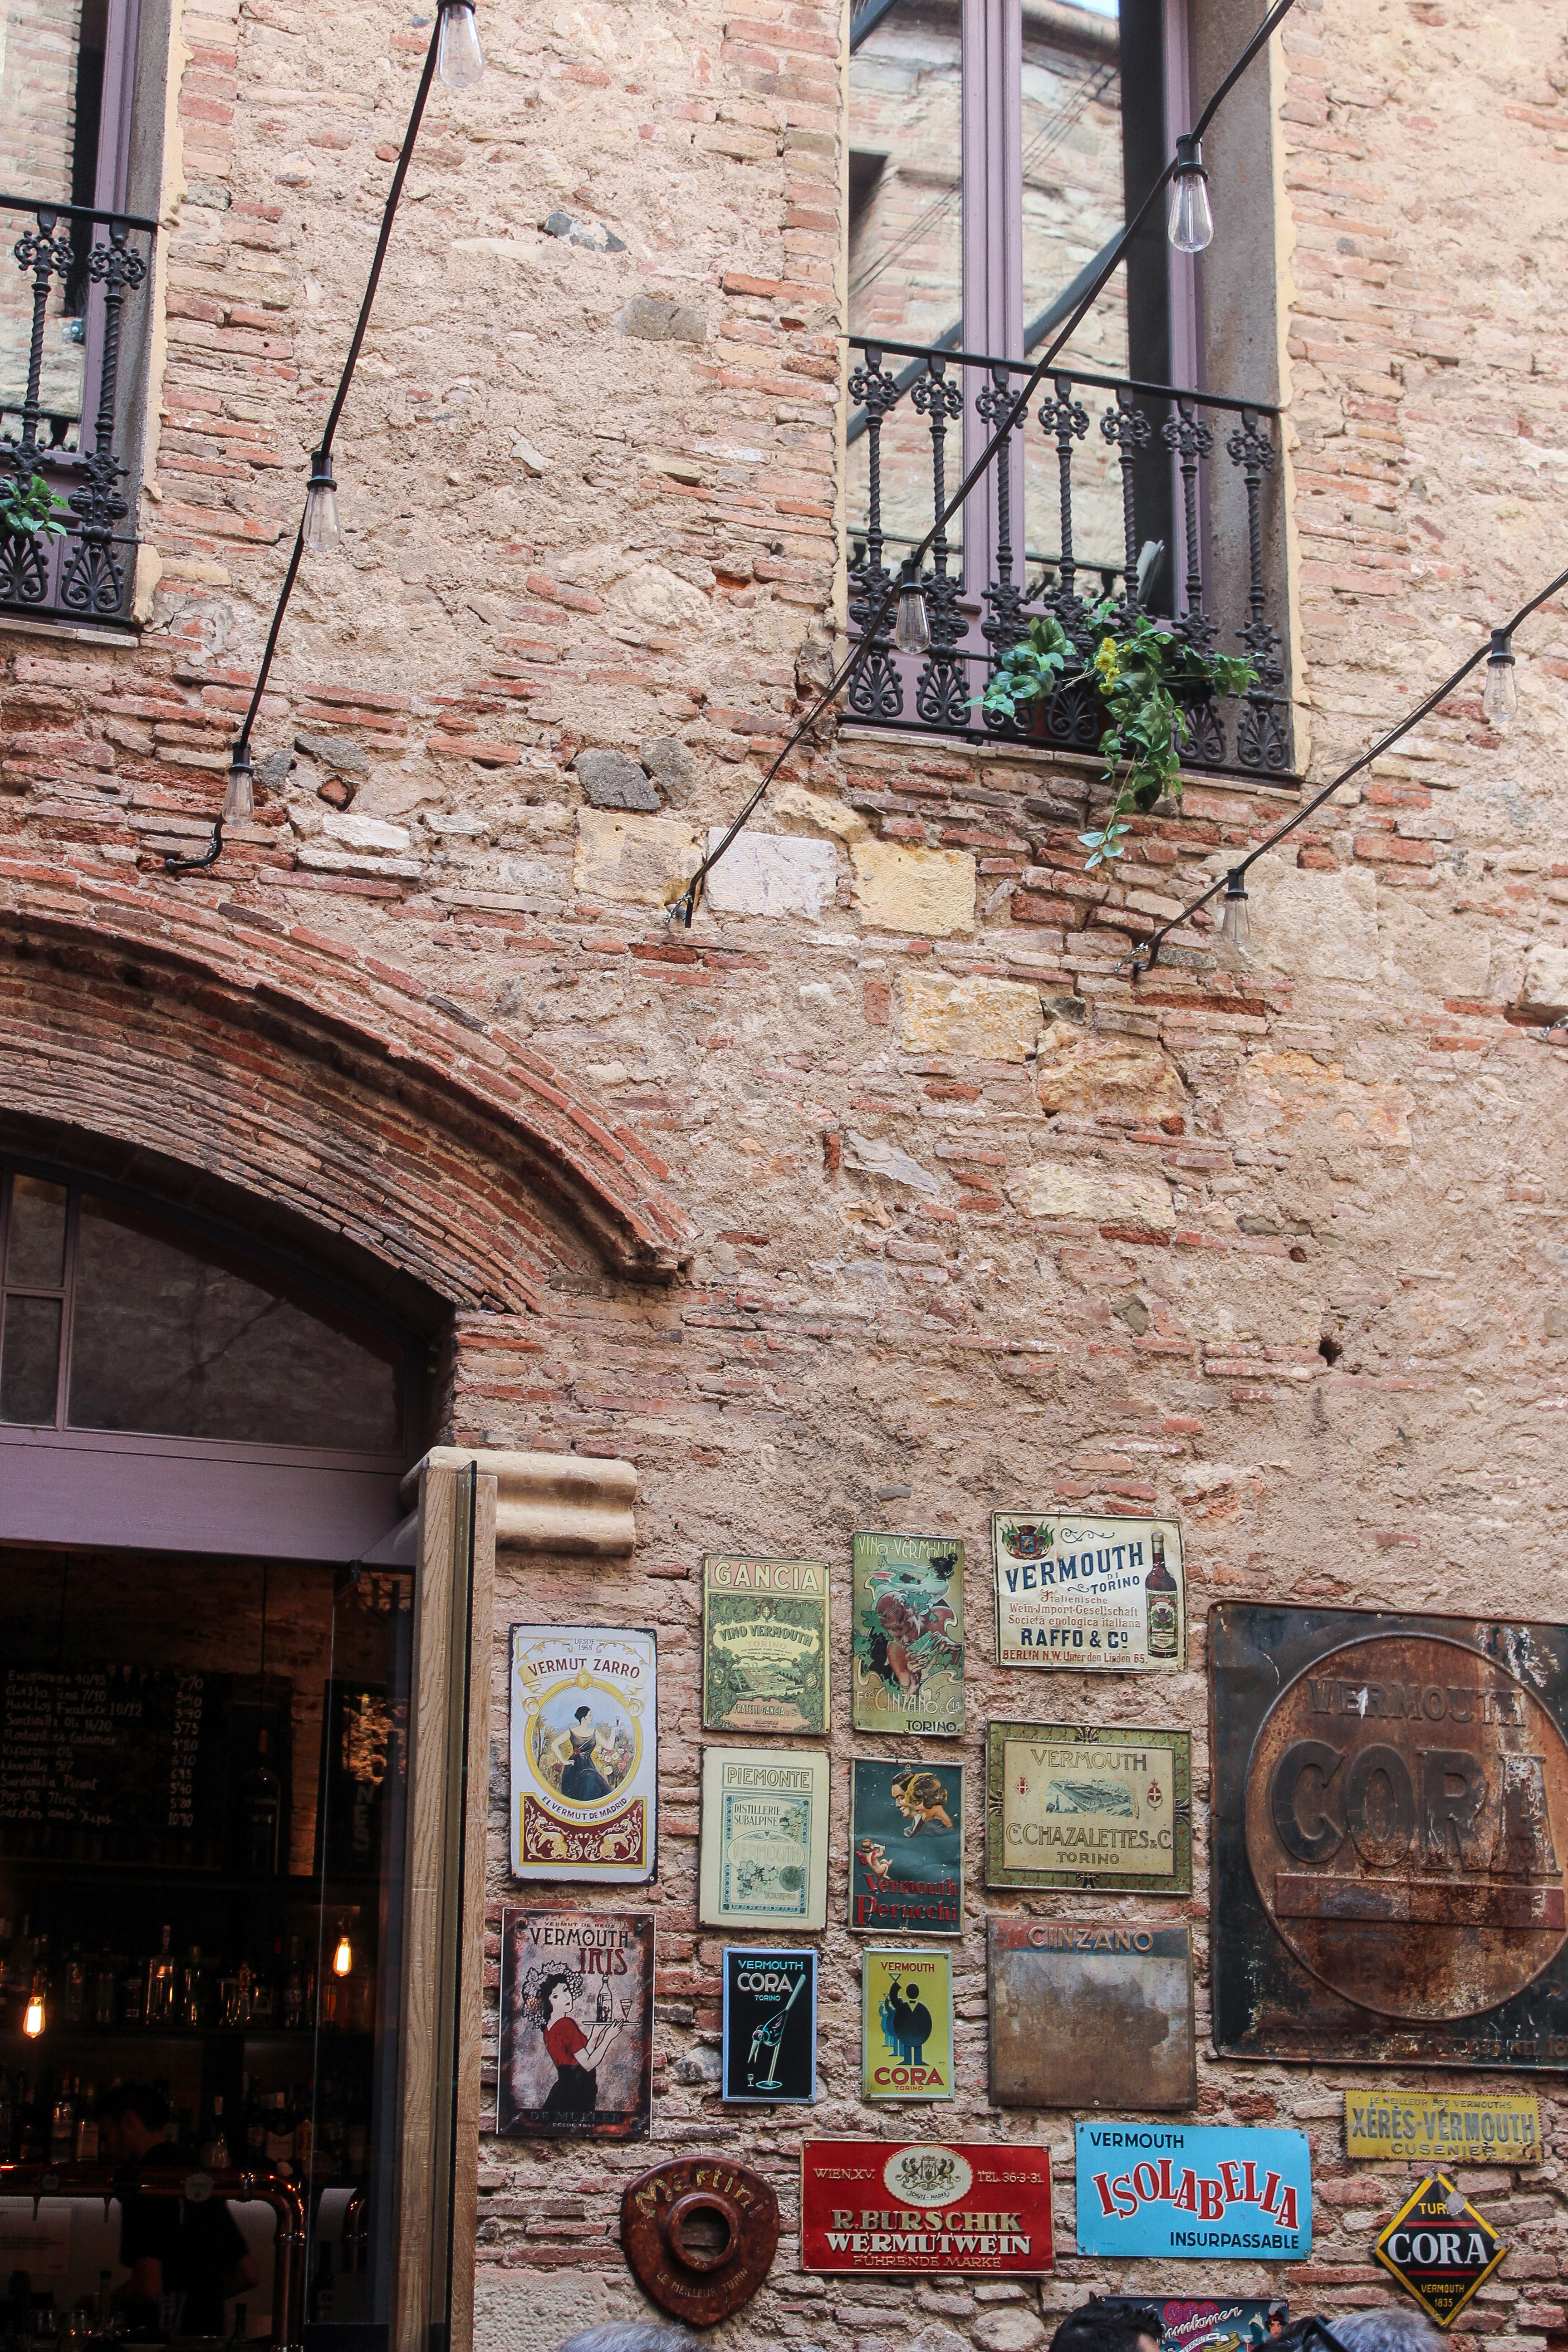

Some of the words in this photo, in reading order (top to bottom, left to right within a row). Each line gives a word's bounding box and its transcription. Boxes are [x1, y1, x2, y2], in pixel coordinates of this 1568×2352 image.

[715, 1562, 818, 1591] GANCIA
[1004, 1541, 1144, 1592] VERMOUTH
[1091, 1575, 1140, 1594] TORINO
[1049, 1616, 1098, 1628] enologica
[1102, 1617, 1140, 1627] italiana
[718, 1626, 747, 1642] VINO
[749, 1625, 813, 1646] VERMOUTH
[747, 1641, 786, 1649] TORINO
[1021, 1627, 1083, 1647] RAFFO
[1090, 1632, 1102, 1647] &
[1003, 1649, 1039, 1660] BERLIN
[1042, 1651, 1061, 1661] N.W.
[1063, 1651, 1085, 1661] Unter
[1088, 1651, 1101, 1662] den
[1104, 1653, 1130, 1663] Linden
[528, 1658, 587, 1677] VERMUT
[593, 1659, 640, 1678] ZARRO
[109, 1702, 143, 1716] 10/12
[733, 1704, 760, 1714] FRATELLI
[761, 1705, 784, 1715] GANCIA
[875, 1687, 938, 1714] CINZANO
[1308, 1677, 1527, 1727] VERMOUTH
[1031, 1749, 1147, 1771] VERMOUTH
[727, 1767, 809, 1788] PIEMONTE
[542, 1796, 549, 1807] EL
[552, 1802, 587, 1820] VERMUT
[600, 1798, 627, 1818] MADRID
[735, 1804, 781, 1815] DISTILLERIE
[1272, 1739, 1563, 1877] CORA
[734, 1815, 778, 1826] SUBALPINE
[733, 1842, 800, 1862] VERMOUTH
[1058, 1852, 1119, 1865] TORINO
[863, 1873, 958, 1896] Vermouth
[855, 1895, 957, 1926] Perucchi
[530, 1928, 628, 1948] VERMOUTH
[1028, 1926, 1154, 1952] CINZANO
[579, 1948, 628, 1975] IRIS
[738, 1960, 803, 1970] VERMOUTH
[880, 1961, 935, 1972] VERMOUTH
[737, 1973, 793, 1992] CORA
[1509, 2039, 1540, 2057] NEL
[1547, 2034, 1568, 2058] 18
[874, 2067, 944, 2086] CORA
[1370, 2096, 1380, 2104] LE
[1383, 2097, 1427, 2106] MEILLEUR
[1454, 2100, 1512, 2109] VERMOUTHS
[1090, 2132, 1184, 2149] VERMOUTH
[1391, 2141, 1496, 2156] CUSENIER
[635, 2167, 770, 2218] Martini
[1093, 2158, 1299, 2230] ISOLABELLA
[1418, 2203, 1449, 2215] TUR
[825, 2232, 1031, 2255] WERMUTWEIN
[1170, 2232, 1298, 2249] INSURPASSABLE
[1387, 2233, 1490, 2264] CORA
[853, 2252, 939, 2267] FÜHRENDE
[944, 2256, 1002, 2268] MARKE
[657, 2271, 669, 2284] LE
[671, 2283, 717, 2298] MEILLEUR
[722, 2268, 748, 2292] TURIN
[1421, 2283, 1465, 2293] VERMOUTH
[1434, 2298, 1453, 2307] 1835
